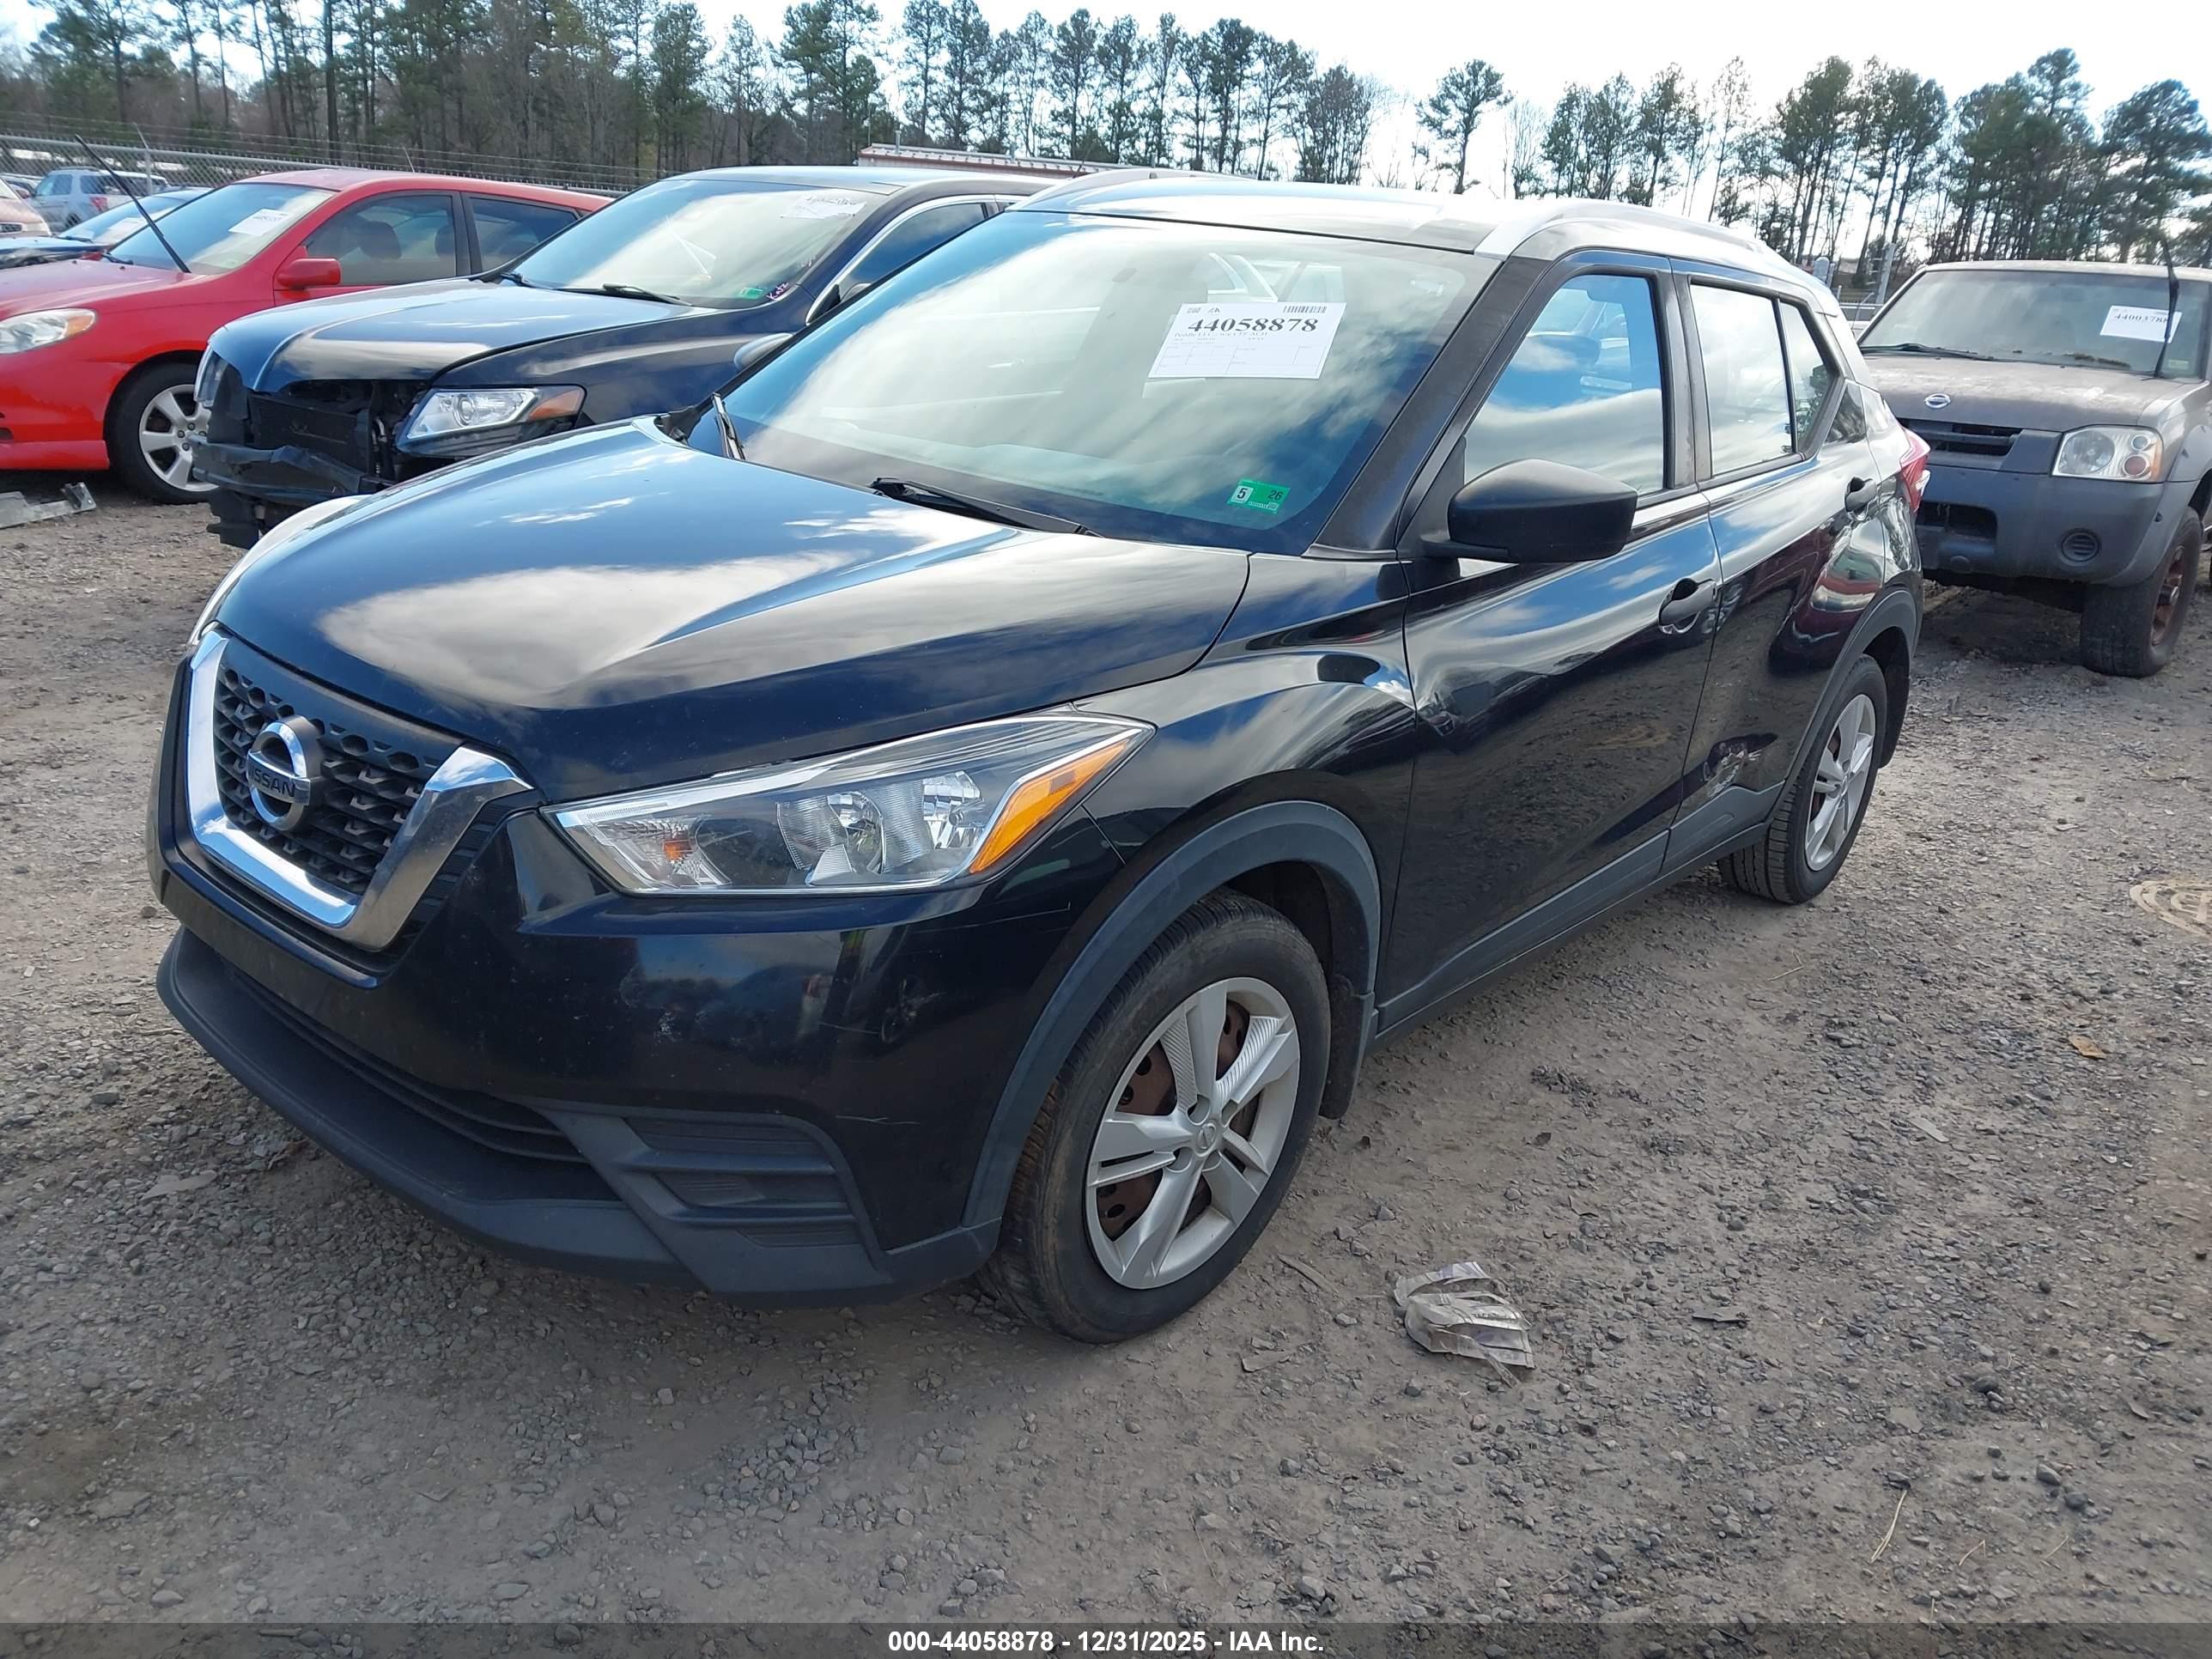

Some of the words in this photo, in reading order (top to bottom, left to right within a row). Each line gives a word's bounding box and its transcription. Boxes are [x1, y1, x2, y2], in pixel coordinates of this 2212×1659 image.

[1188, 318, 1319, 331] 44058878
[1237, 487, 1248, 499] 5
[1268, 489, 1284, 501] 26
